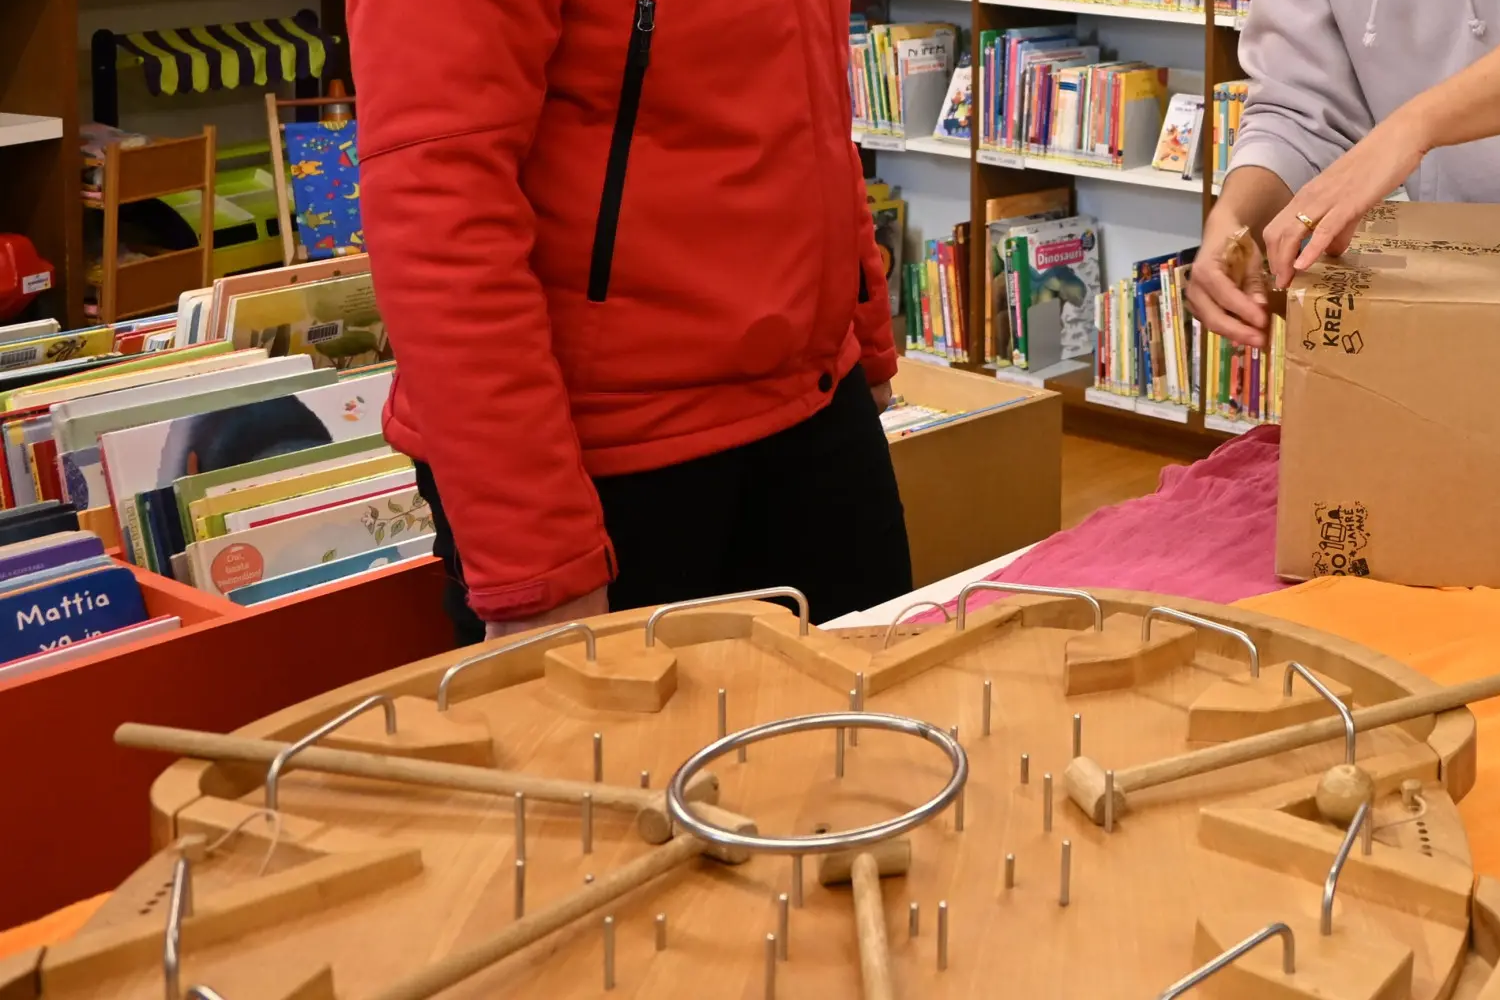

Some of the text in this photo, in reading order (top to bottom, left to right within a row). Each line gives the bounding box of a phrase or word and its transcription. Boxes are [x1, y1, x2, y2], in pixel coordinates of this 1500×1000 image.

[1037, 248, 1082, 265] Dinosauri
[1344, 508, 1357, 548] JAHRE
[17, 589, 110, 631] Mattia
